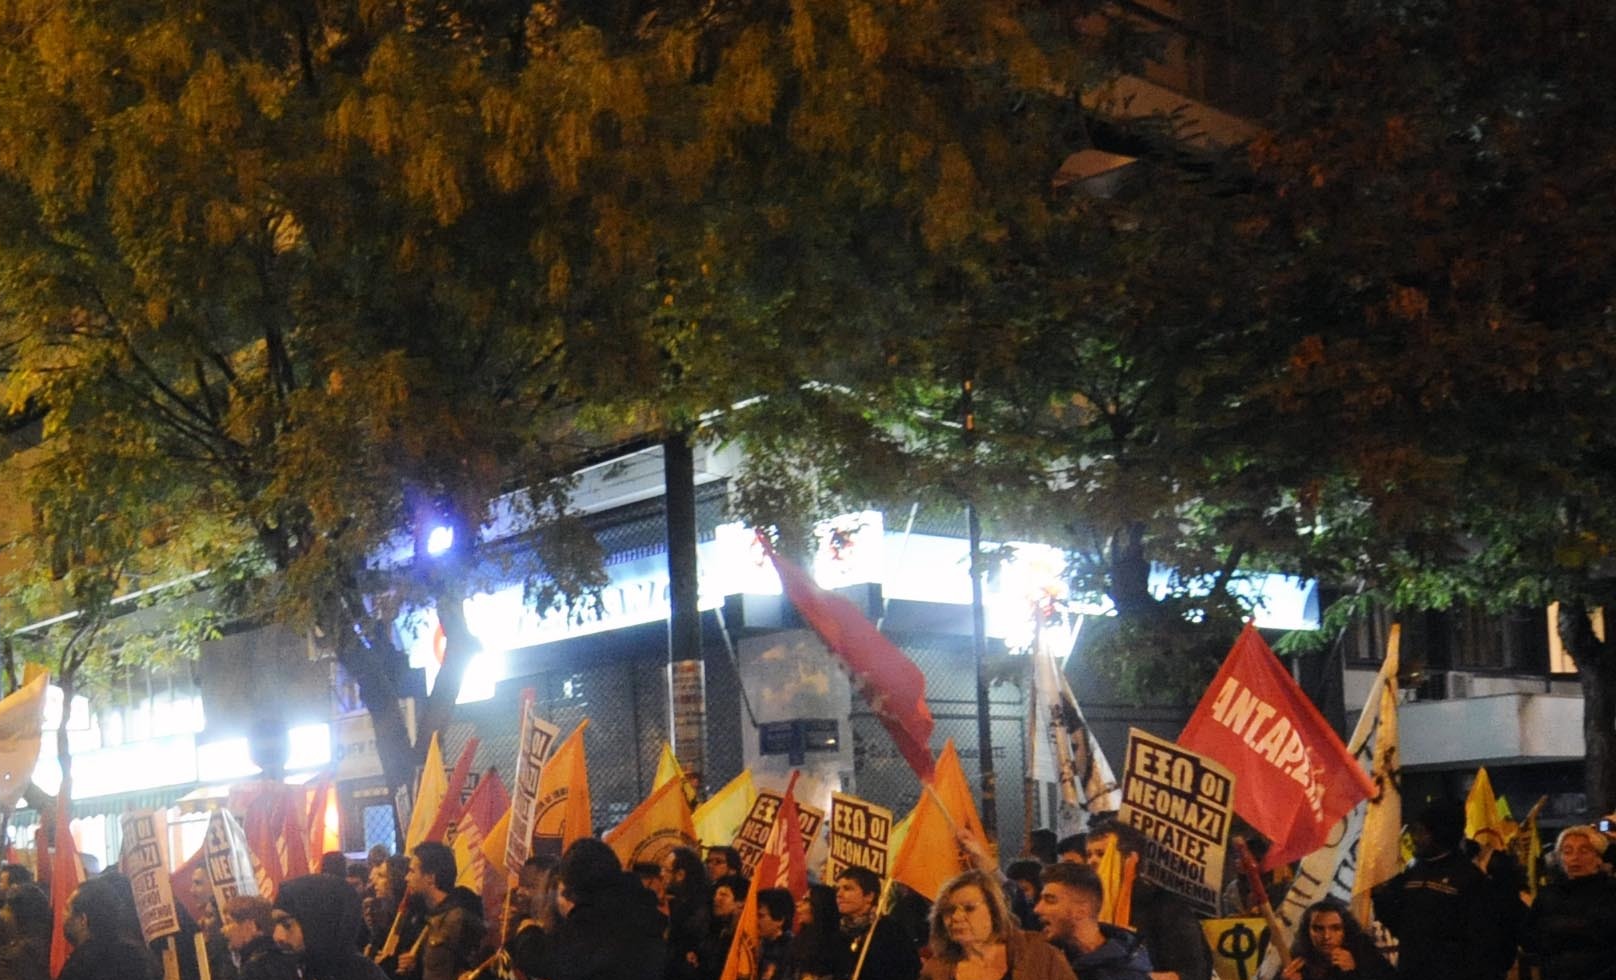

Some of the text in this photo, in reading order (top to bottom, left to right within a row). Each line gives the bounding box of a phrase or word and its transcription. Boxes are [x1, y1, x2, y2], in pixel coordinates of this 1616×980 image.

[1135, 742, 1224, 802] ΕΞΩ ΟΙ
[834, 801, 886, 842] ΕΞΩ ΟΙ
[1127, 776, 1222, 839] ΝΕΟΝΑΖΙ
[833, 834, 885, 876] ΝΕΟΝΑΖΙ
[1130, 810, 1210, 865] ΕΡΓΑΤΕΣ
[1146, 842, 1205, 884] ΩΜΕΝΟΙ
